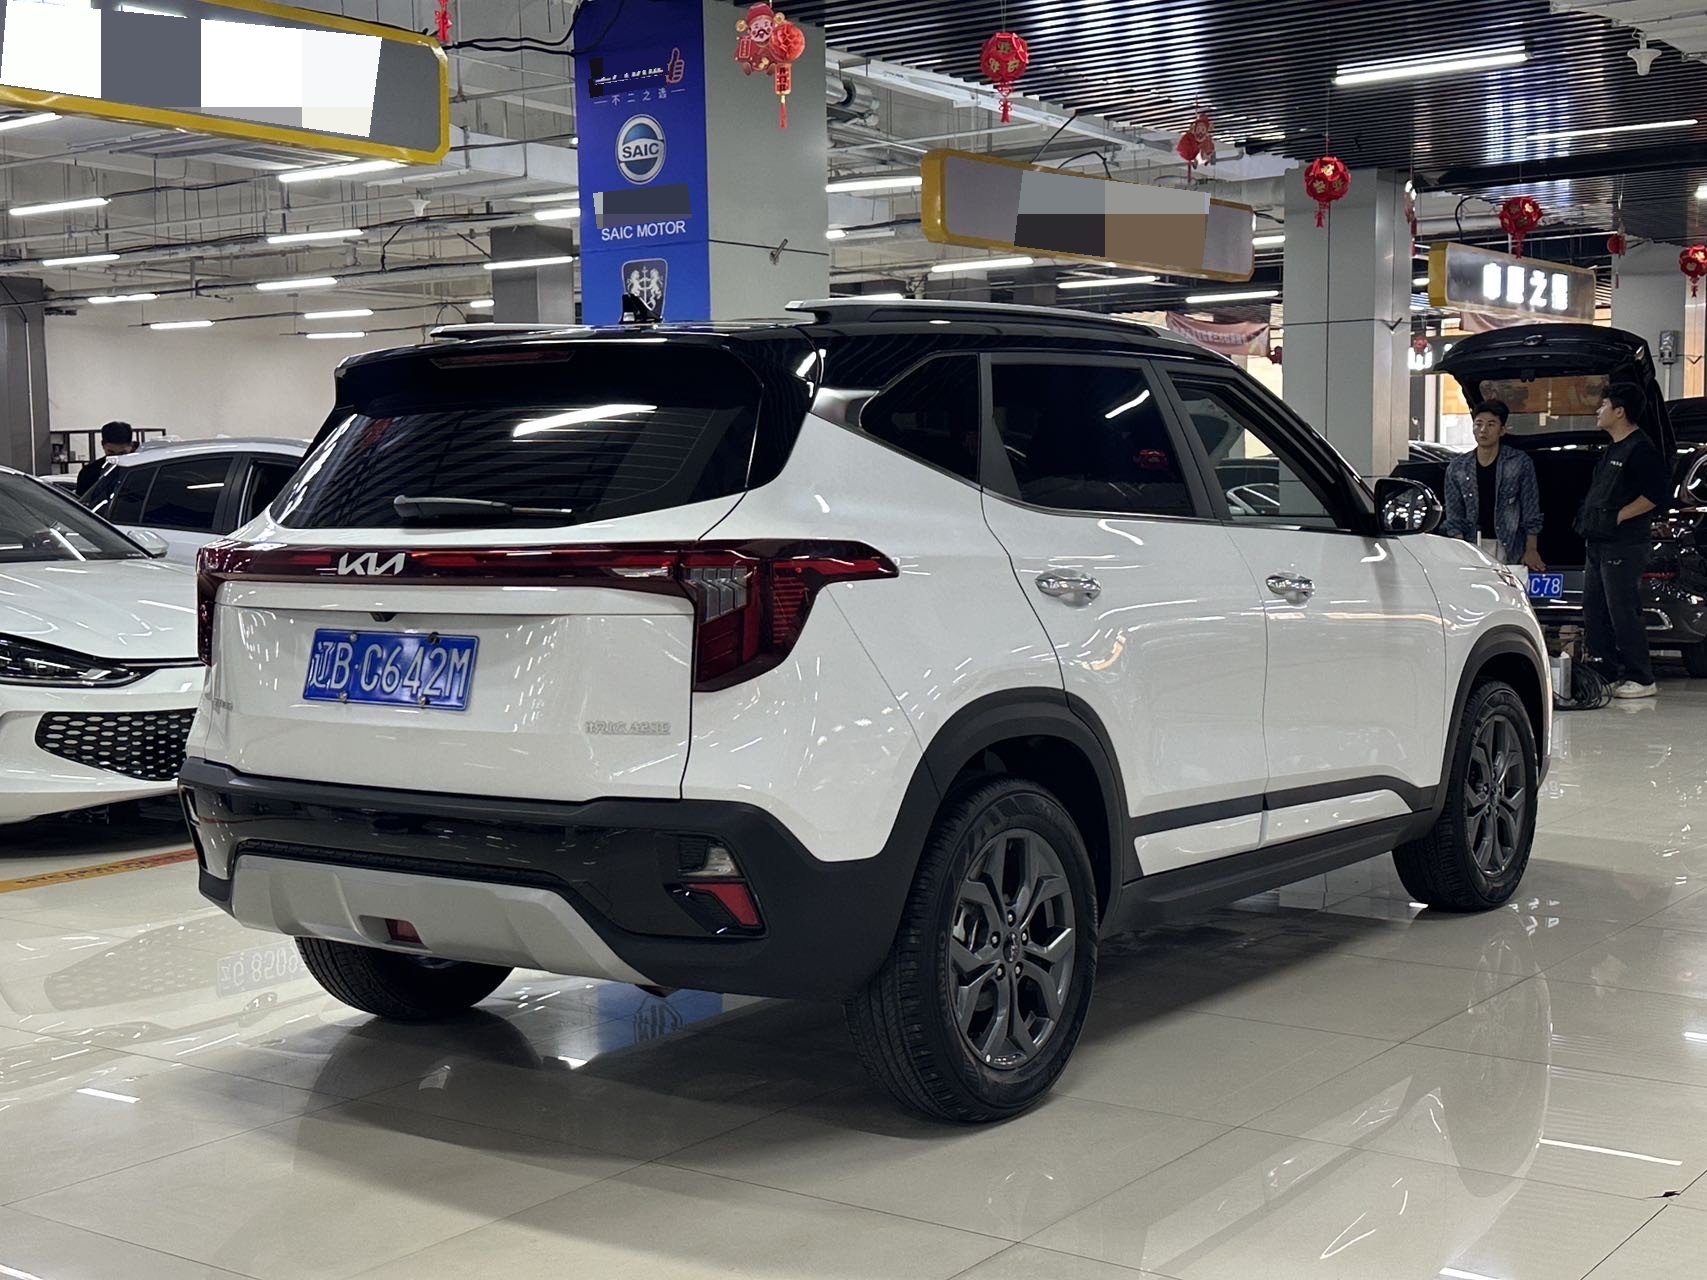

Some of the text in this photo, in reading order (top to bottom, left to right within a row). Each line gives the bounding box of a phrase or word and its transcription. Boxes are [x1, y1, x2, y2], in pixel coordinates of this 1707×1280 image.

[622, 143, 659, 159] SAIC
[601, 220, 686, 241] SAIC MOTOR
[337, 552, 406, 576] KIA
[1527, 577, 1561, 595] C78
